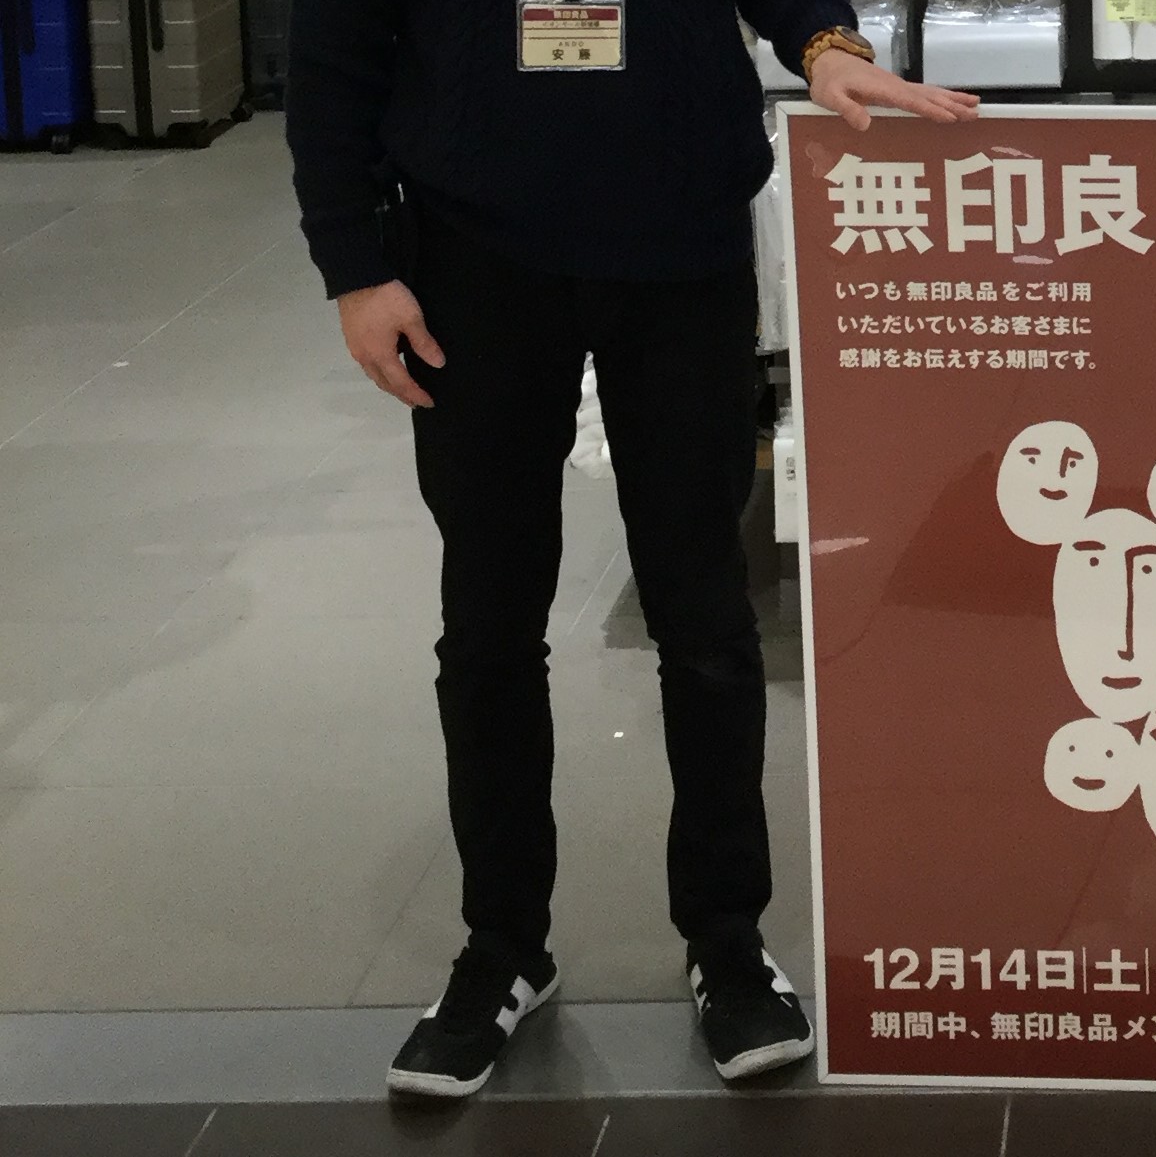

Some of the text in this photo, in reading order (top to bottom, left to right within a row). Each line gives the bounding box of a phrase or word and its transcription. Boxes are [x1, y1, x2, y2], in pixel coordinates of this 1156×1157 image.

[837, 314, 1092, 336] いただいているお客さまに
[839, 348, 1098, 371] 感謝をお伝えする期間です。
